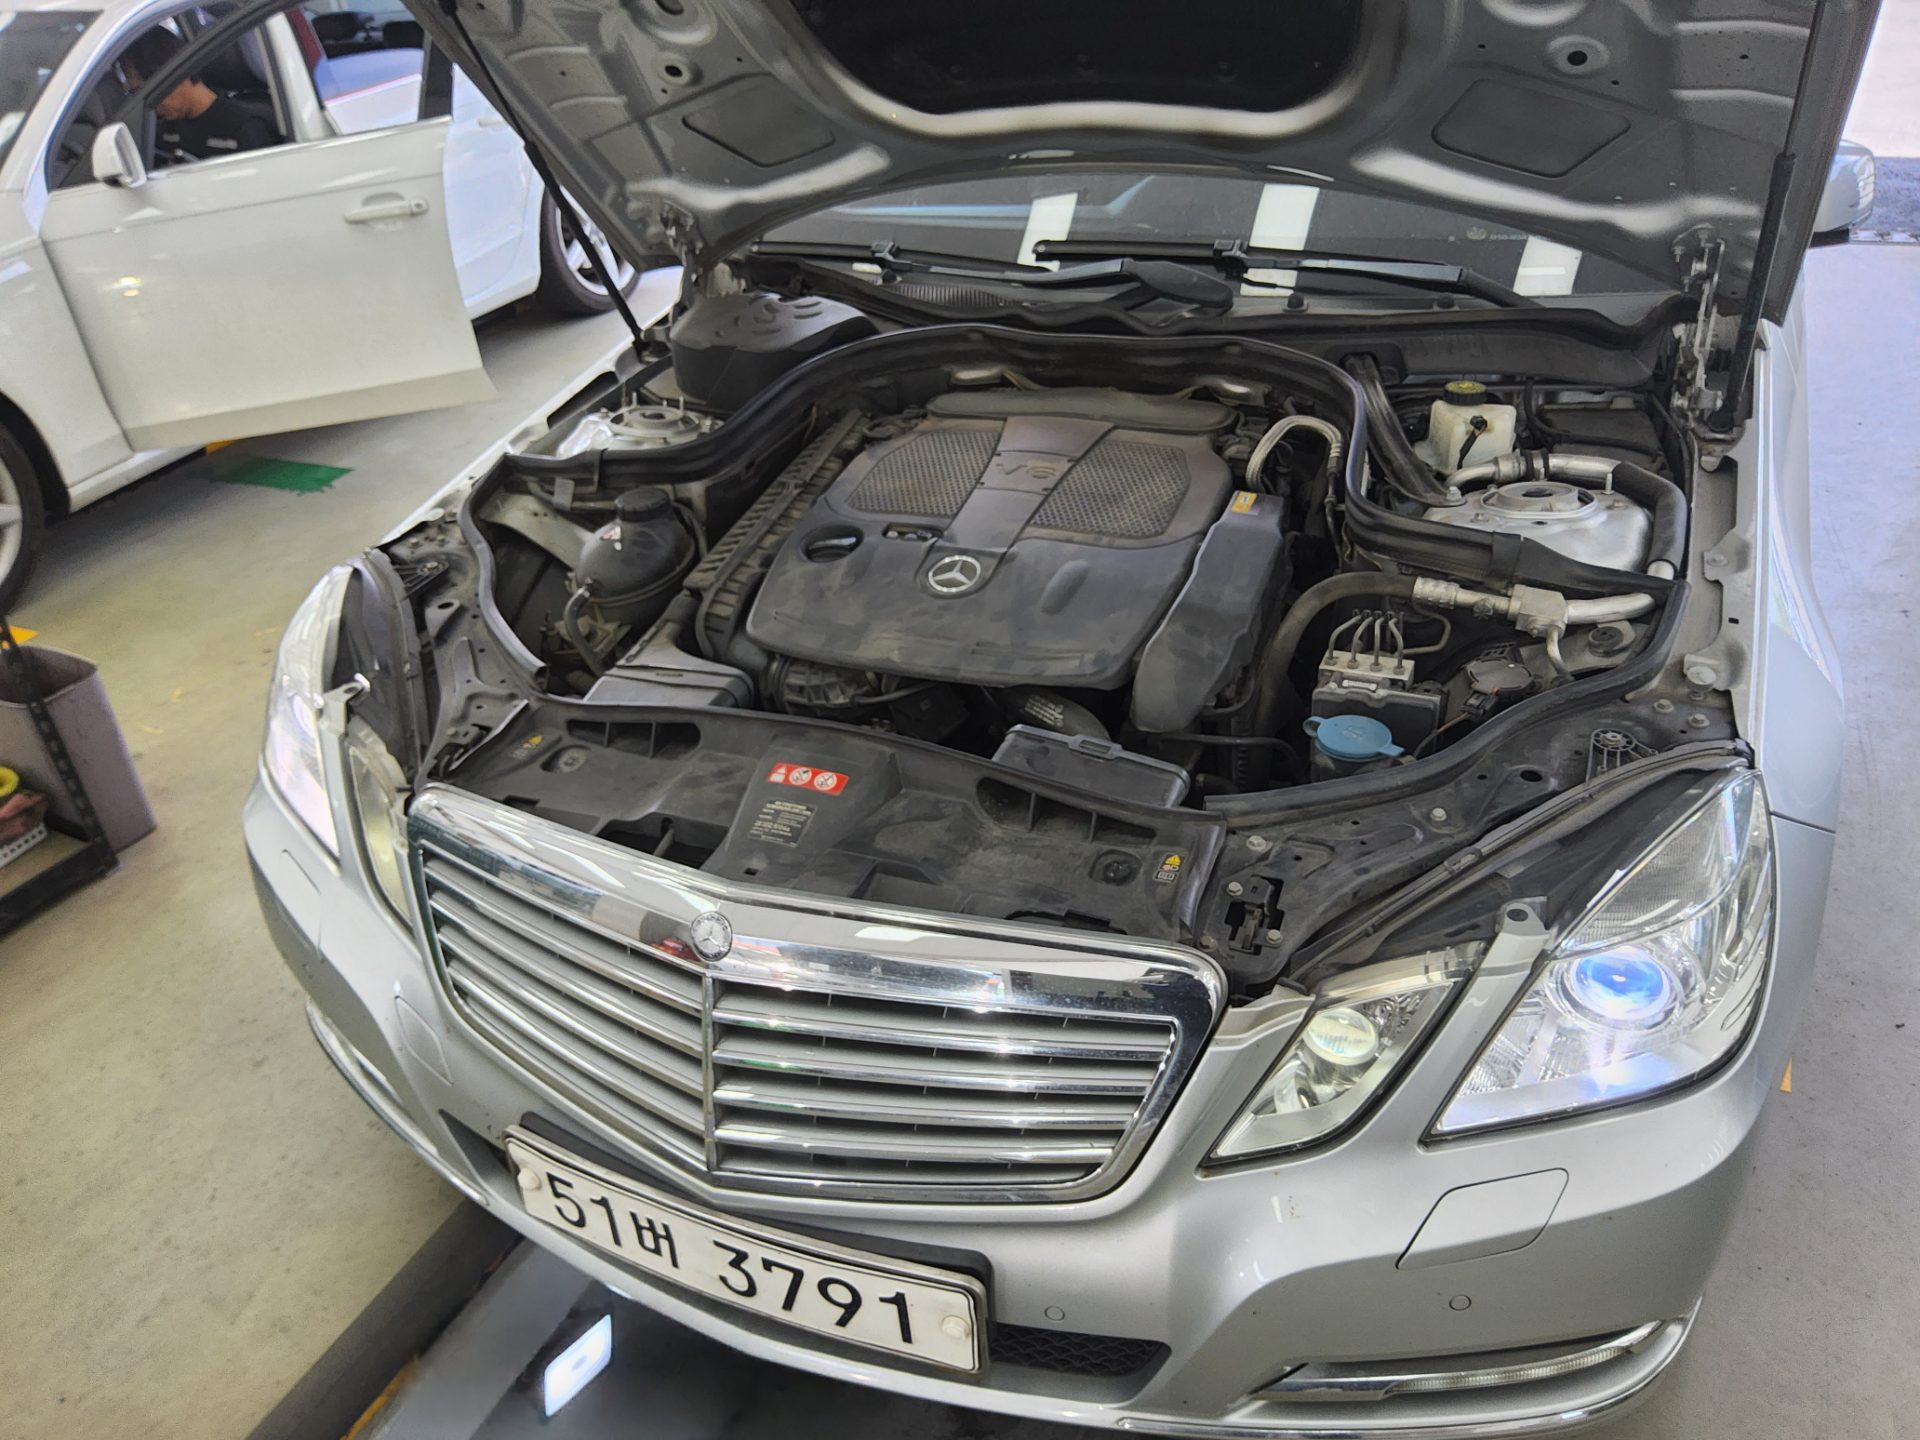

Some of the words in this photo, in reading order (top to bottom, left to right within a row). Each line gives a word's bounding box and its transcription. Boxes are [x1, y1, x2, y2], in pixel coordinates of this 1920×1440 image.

[996, 460, 1057, 480] V6
[546, 1172, 680, 1268] 51버
[713, 1240, 913, 1344] 3791
